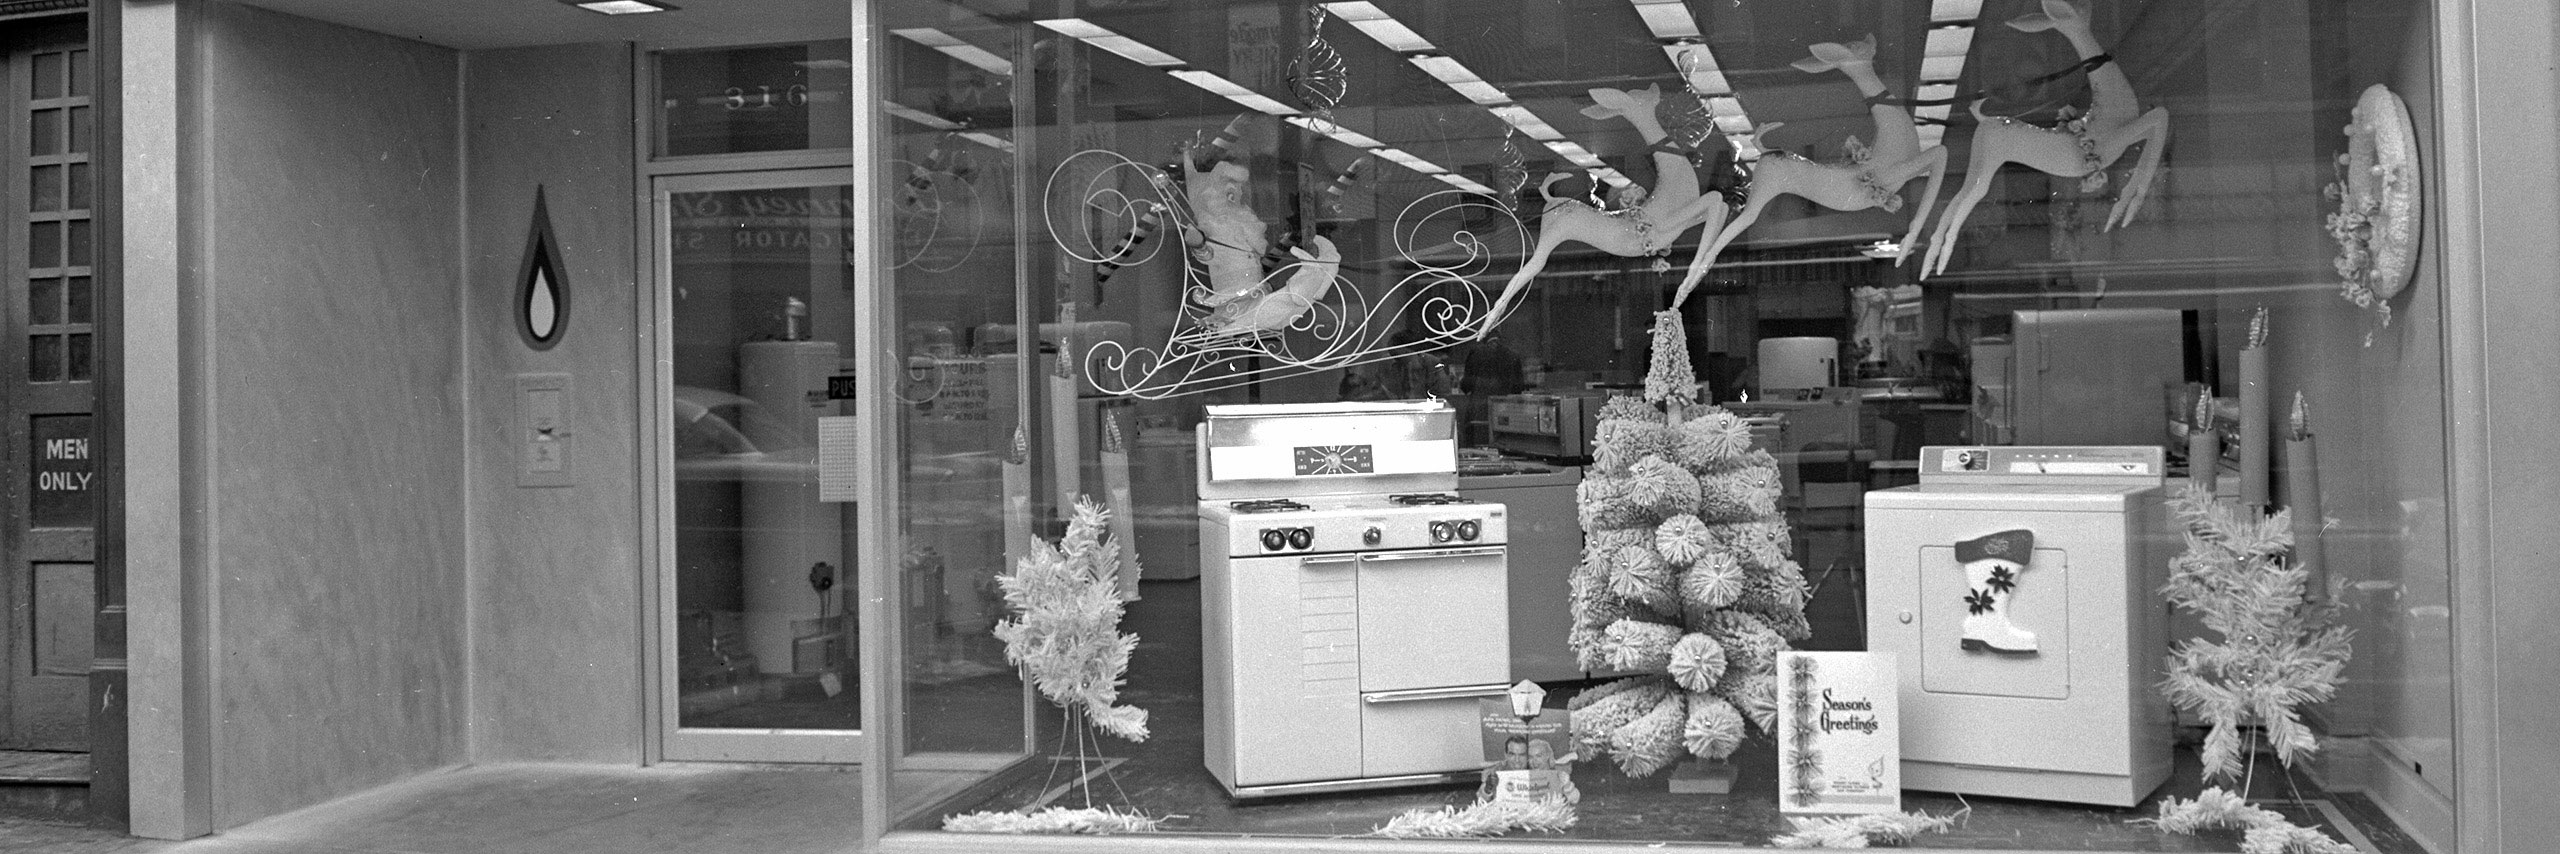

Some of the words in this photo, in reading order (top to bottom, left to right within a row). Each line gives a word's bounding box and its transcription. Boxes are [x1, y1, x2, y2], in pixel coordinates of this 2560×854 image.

[725, 84, 807, 110] 316
[832, 380, 855, 396] PUS
[47, 438, 88, 459] MEN
[40, 471, 93, 491] ONLY
[1823, 687, 1872, 711] Season's
[1821, 711, 1878, 735] Greetings
[1516, 781, 1550, 791] Whirll
